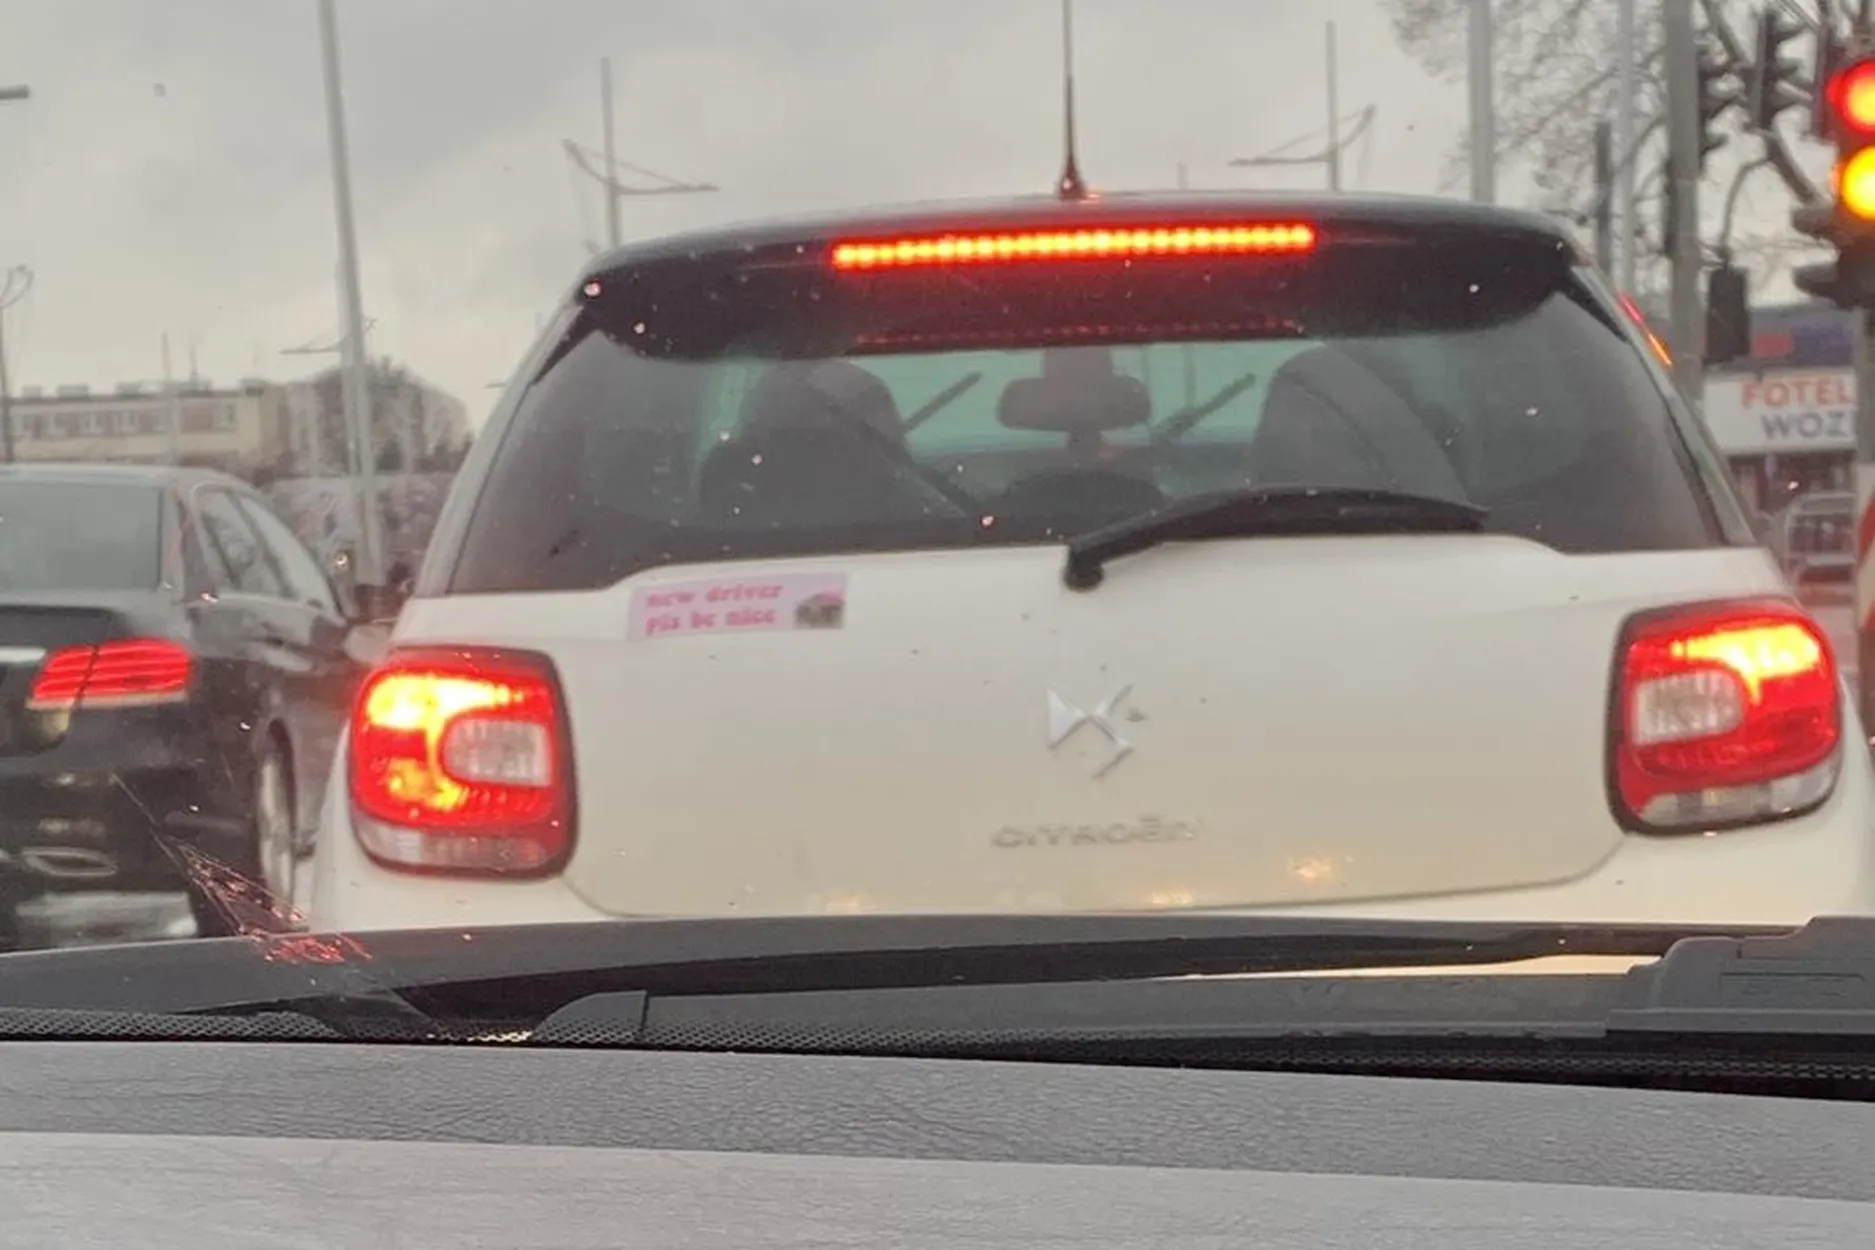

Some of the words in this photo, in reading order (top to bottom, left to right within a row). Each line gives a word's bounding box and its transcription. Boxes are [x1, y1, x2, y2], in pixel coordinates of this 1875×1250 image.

[647, 591, 695, 607] new
[705, 583, 783, 603] driver
[690, 610, 716, 629] be
[726, 608, 776, 625] nice
